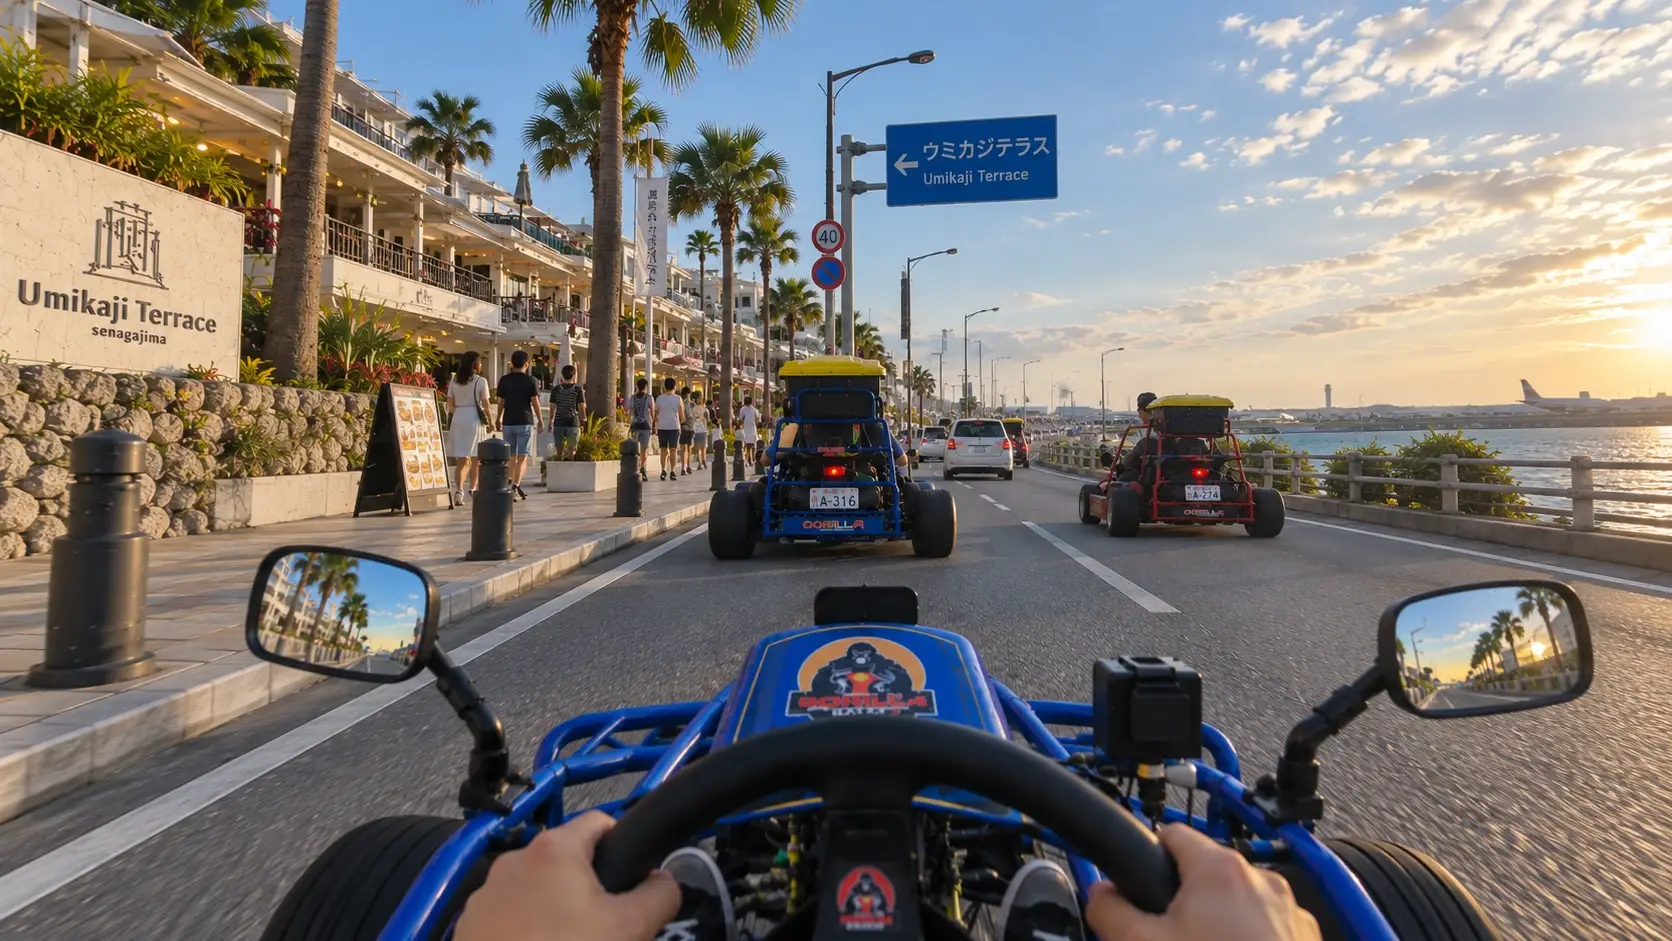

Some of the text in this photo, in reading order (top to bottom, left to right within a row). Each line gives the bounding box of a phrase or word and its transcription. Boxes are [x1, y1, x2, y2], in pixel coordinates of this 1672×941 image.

[923, 137, 1050, 161] ウミカジテラス
[923, 169, 1029, 186] Umikaji Terrace
[818, 229, 838, 244] 40
[18, 279, 217, 333] Umikaji Terrace
[91, 325, 167, 346] senagajima
[819, 495, 856, 507] A-316
